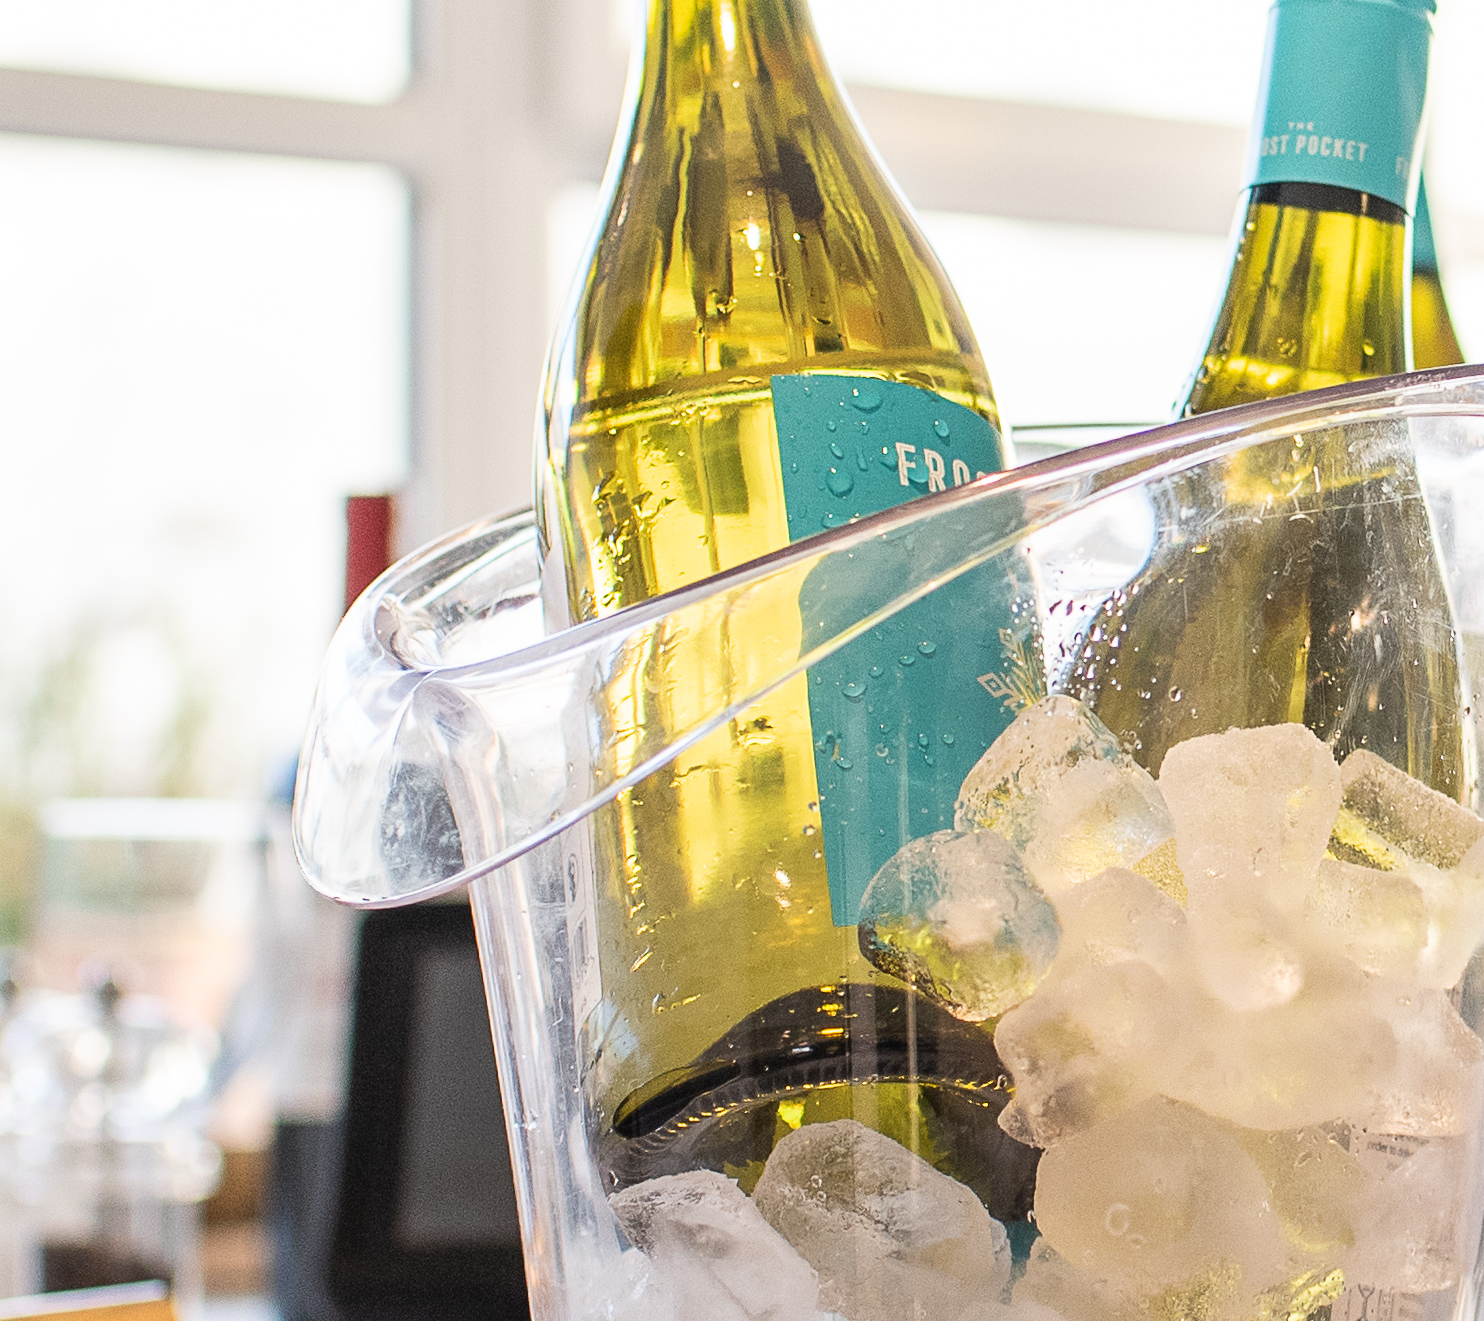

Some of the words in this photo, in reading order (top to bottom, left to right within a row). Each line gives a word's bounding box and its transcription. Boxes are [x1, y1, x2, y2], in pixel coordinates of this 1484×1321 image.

[1261, 133, 1290, 157] OST
[1295, 133, 1370, 163] POCKET
[894, 441, 988, 493] FRO
